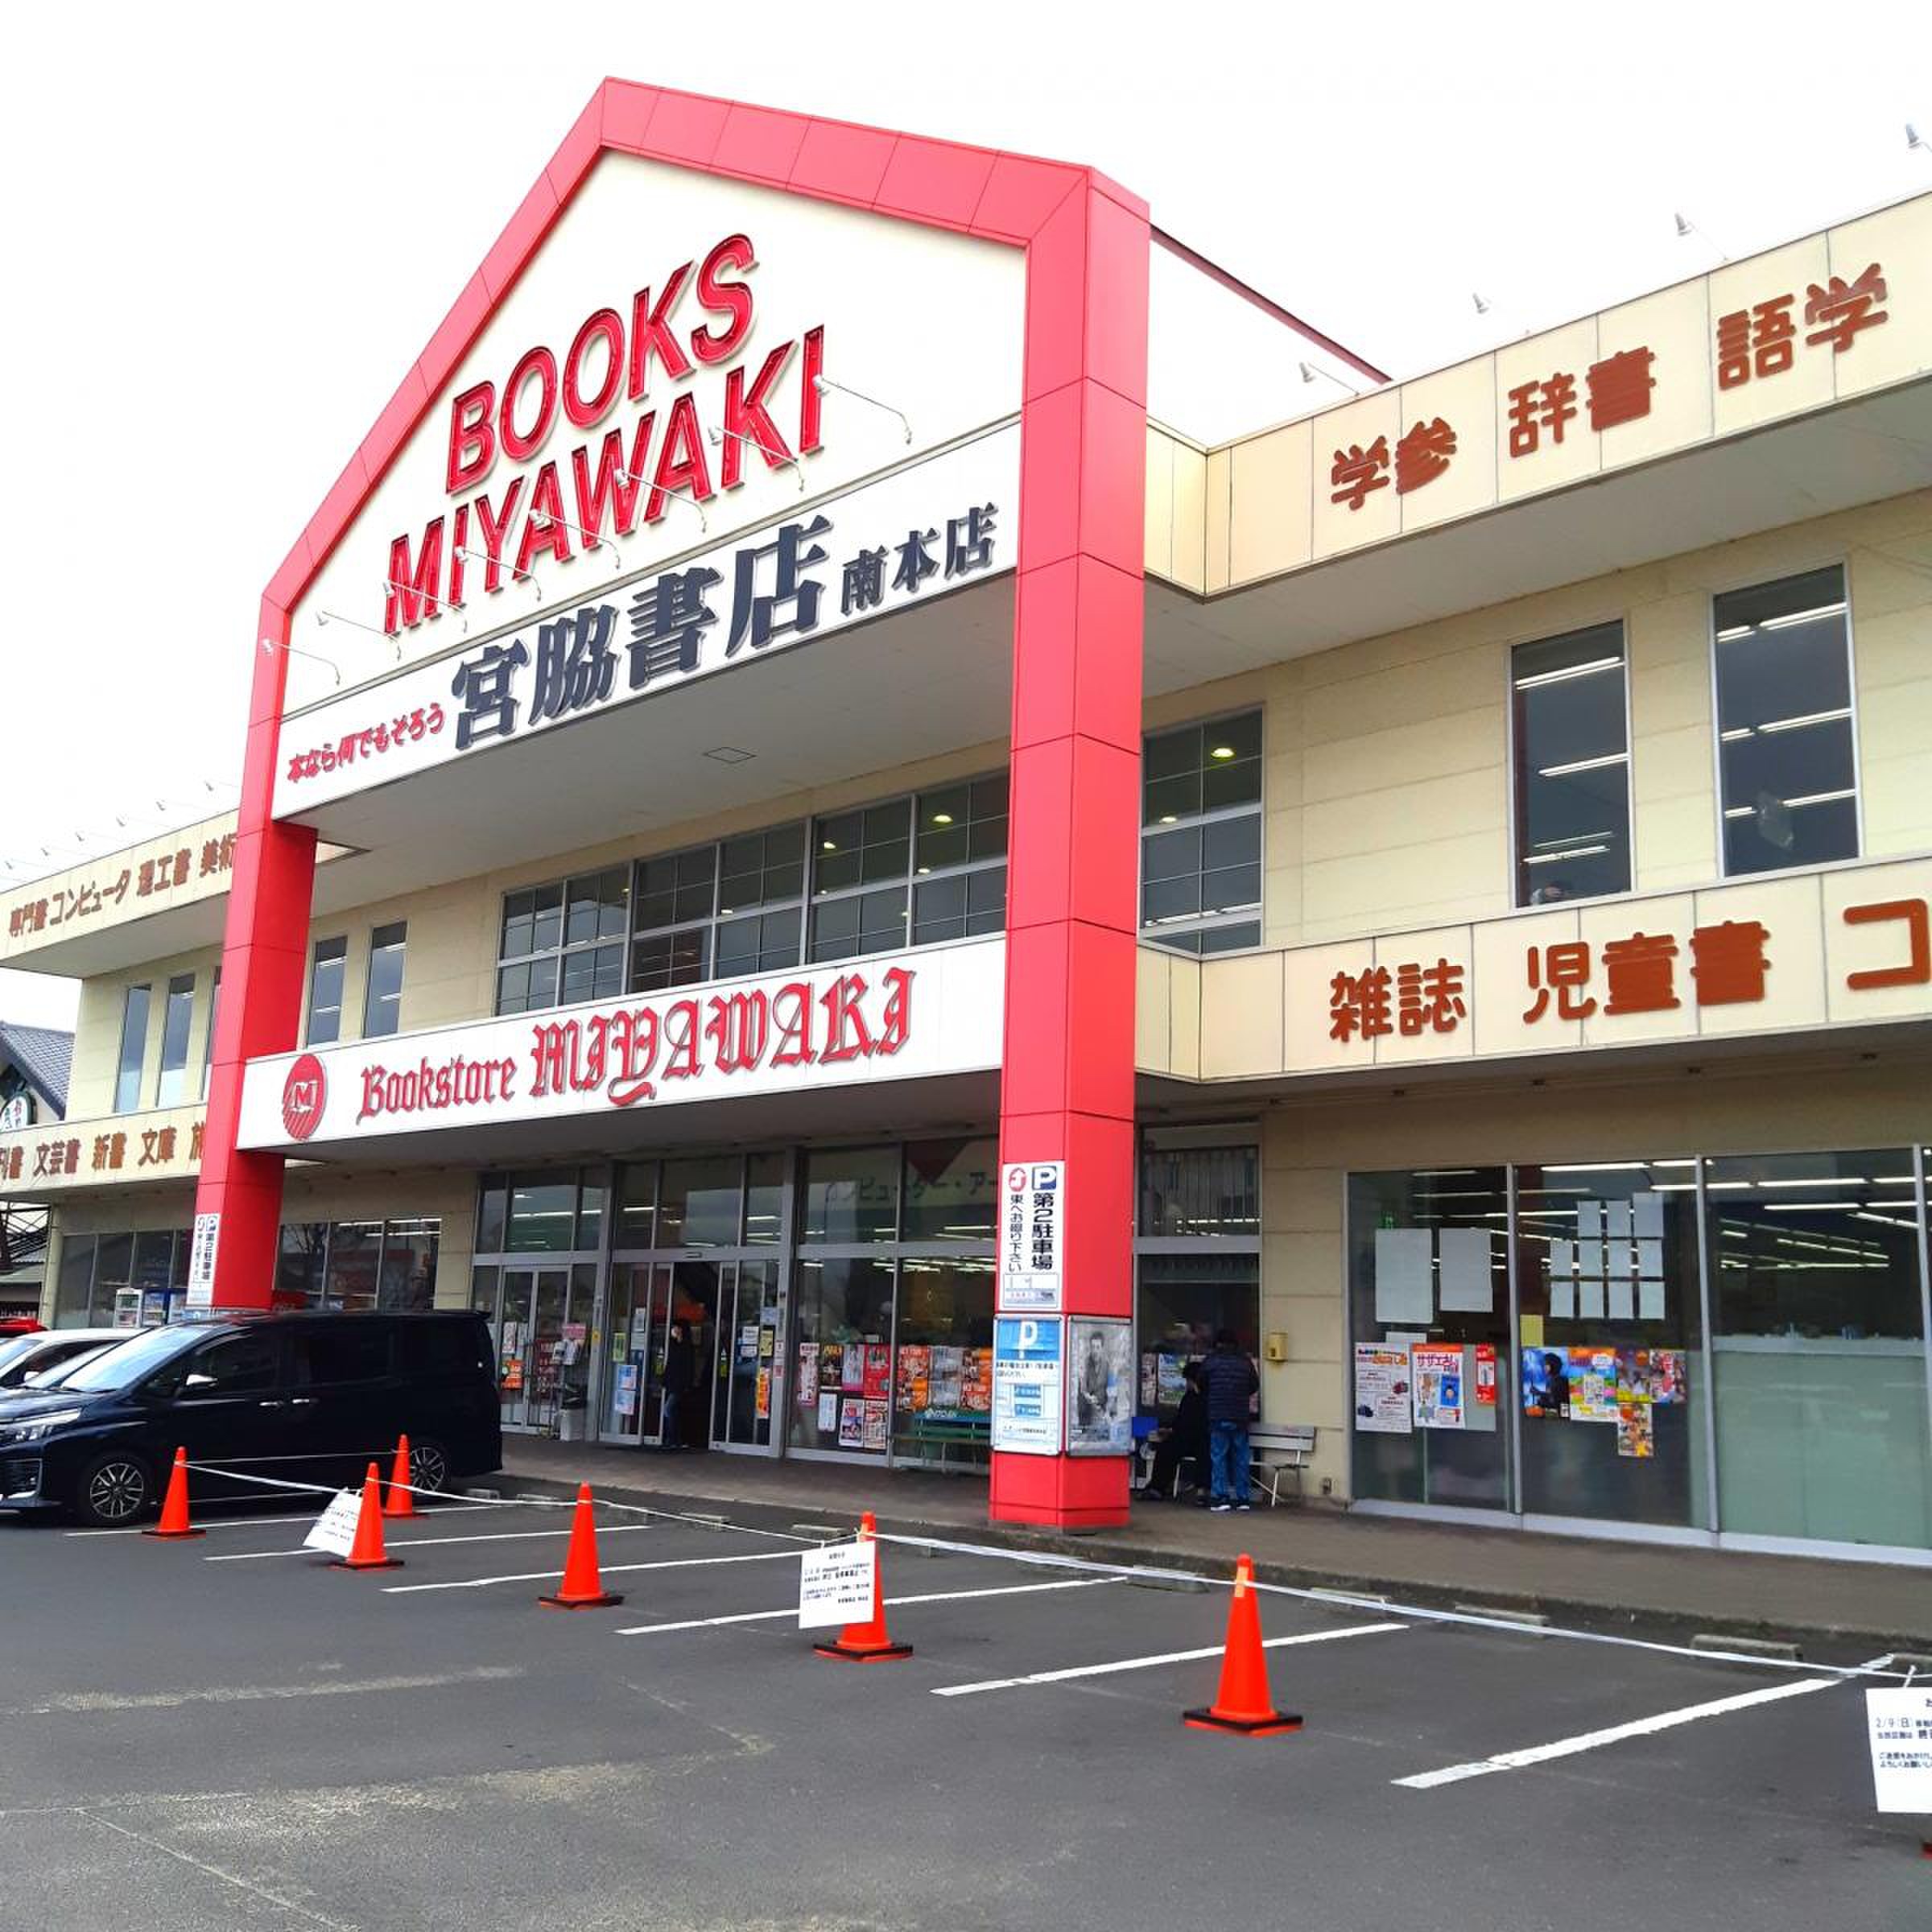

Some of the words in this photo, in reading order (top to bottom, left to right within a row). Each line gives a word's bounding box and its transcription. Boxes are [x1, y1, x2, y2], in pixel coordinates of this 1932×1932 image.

[447, 233, 758, 494] BOOKS
[1331, 418, 1455, 511] 学参
[1509, 346, 1656, 458] 辞書
[1717, 262, 1889, 390] 語学
[384, 325, 825, 635] MIYAWAKI
[287, 702, 446, 782] 本なら何でもそろう
[451, 515, 834, 750] 宮脇書店
[840, 502, 999, 616] 南本店
[9, 899, 48, 938] 専門書
[50, 869, 131, 927] コンピュータ
[136, 848, 192, 898] 理工書
[1329, 959, 1466, 1043] 雑誌
[1523, 921, 1771, 1026] 児童書
[1843, 898, 1930, 991] コ
[356, 1058, 517, 1125] Bookstore
[530, 966, 915, 1108] MIYAWAKI
[34, 1138, 81, 1177] 文芸書
[91, 1131, 127, 1170] 新書
[138, 1125, 177, 1167] 文庫
[1033, 1166, 1056, 1190] P
[1031, 1192, 1055, 1269] 第2駐車場
[1018, 1320, 1038, 1359] P
